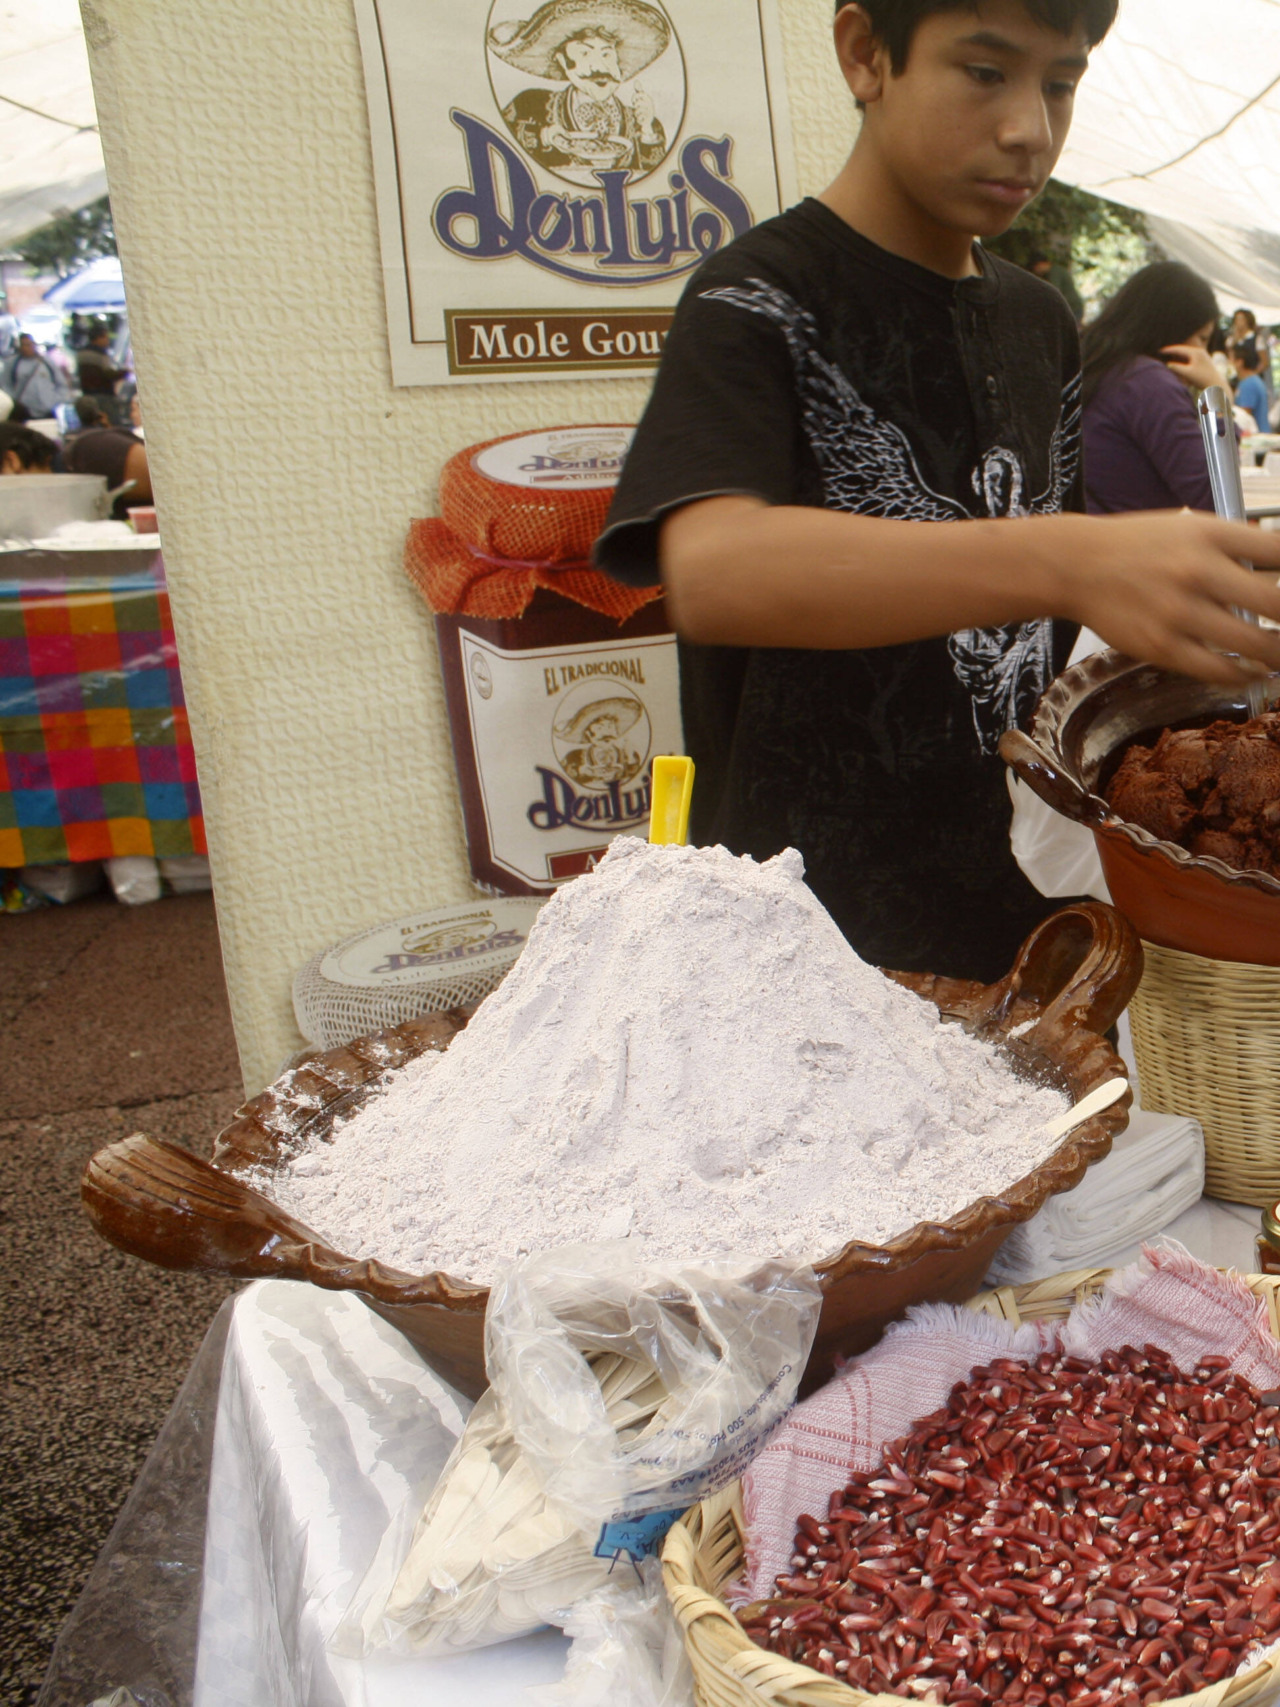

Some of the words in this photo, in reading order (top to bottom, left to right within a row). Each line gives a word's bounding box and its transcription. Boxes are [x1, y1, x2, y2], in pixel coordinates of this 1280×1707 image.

[469, 321, 570, 359] Mole
[544, 667, 560, 696] EL
[561, 657, 645, 686] TRADICIONAL
[727, 1416, 745, 1434] 500
[738, 1436, 759, 1455] MUS
[671, 1475, 696, 1489] AA2
